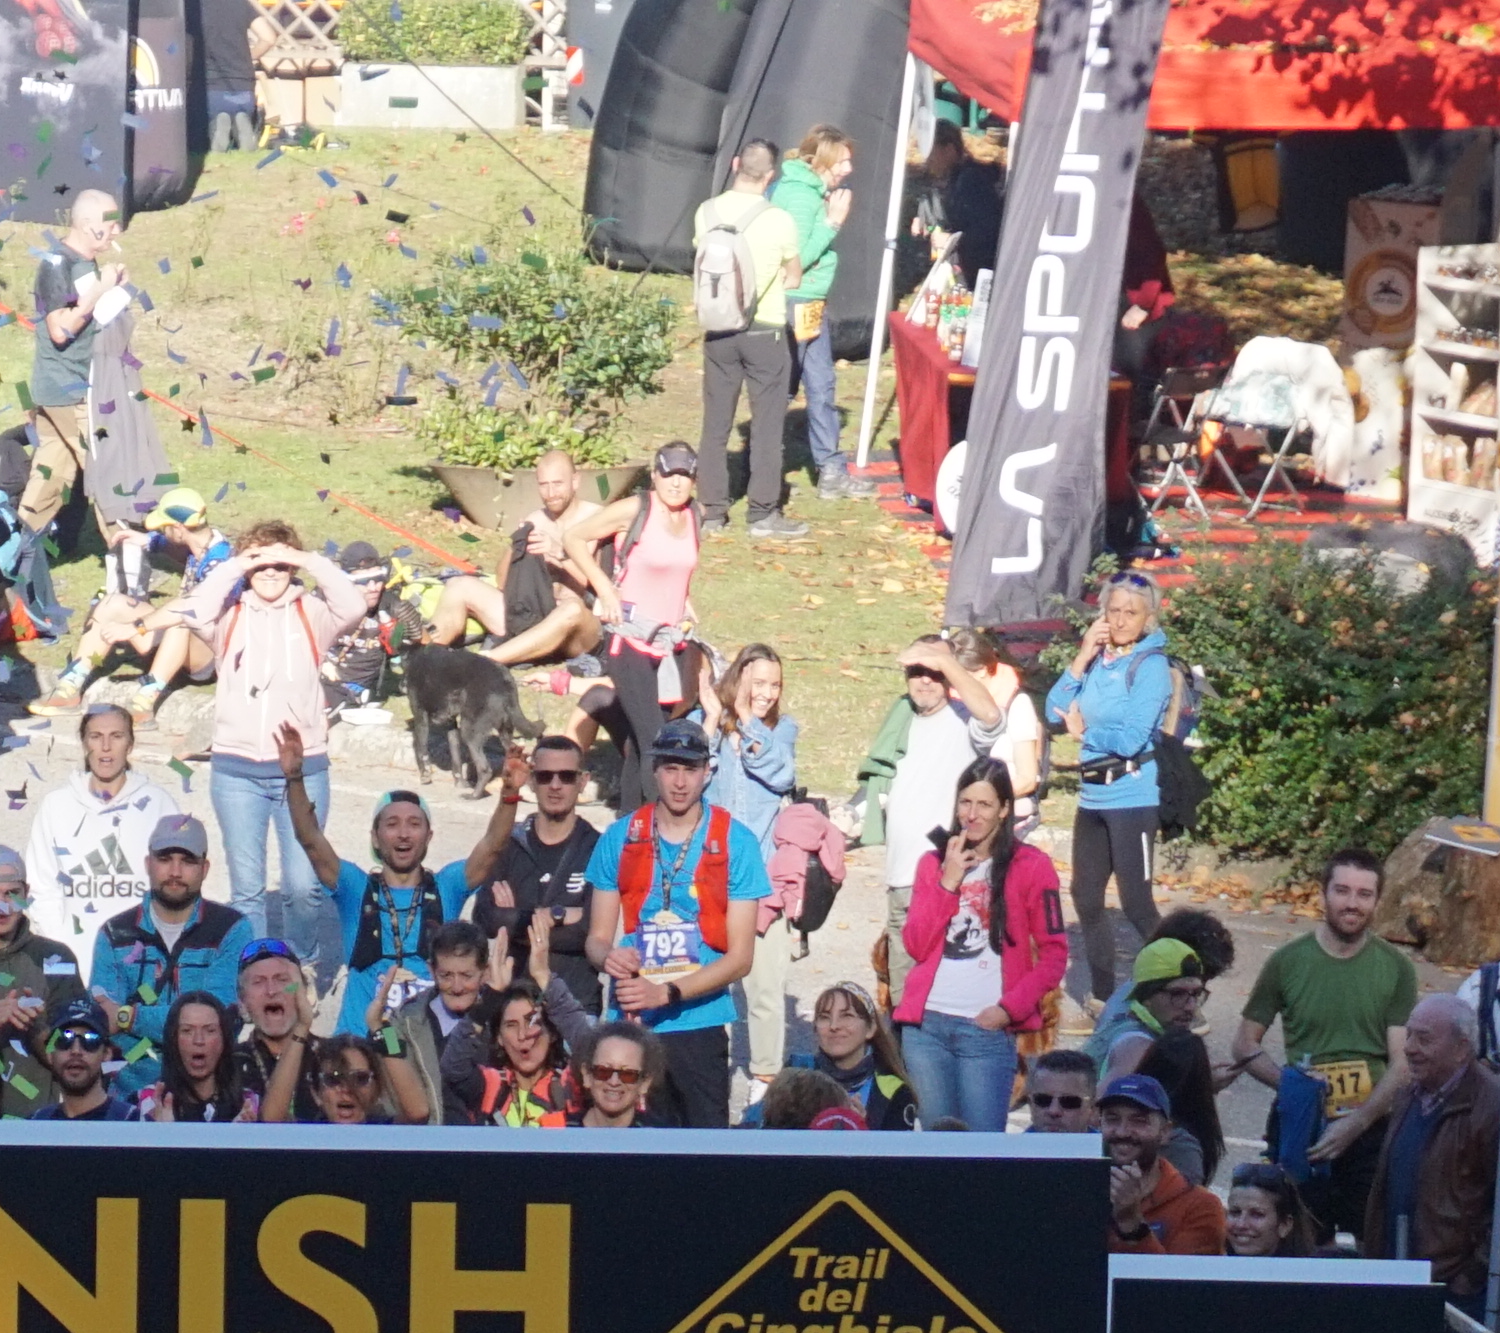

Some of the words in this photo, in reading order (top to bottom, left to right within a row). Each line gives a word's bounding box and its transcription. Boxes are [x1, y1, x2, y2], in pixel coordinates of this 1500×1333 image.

[991, 443, 1058, 575] LA
[62, 876, 147, 899] adidas
[643, 931, 687, 957] 792
[1326, 1072, 1360, 1096] 17
[790, 1248, 889, 1278] Trail
[800, 1282, 867, 1312] del
